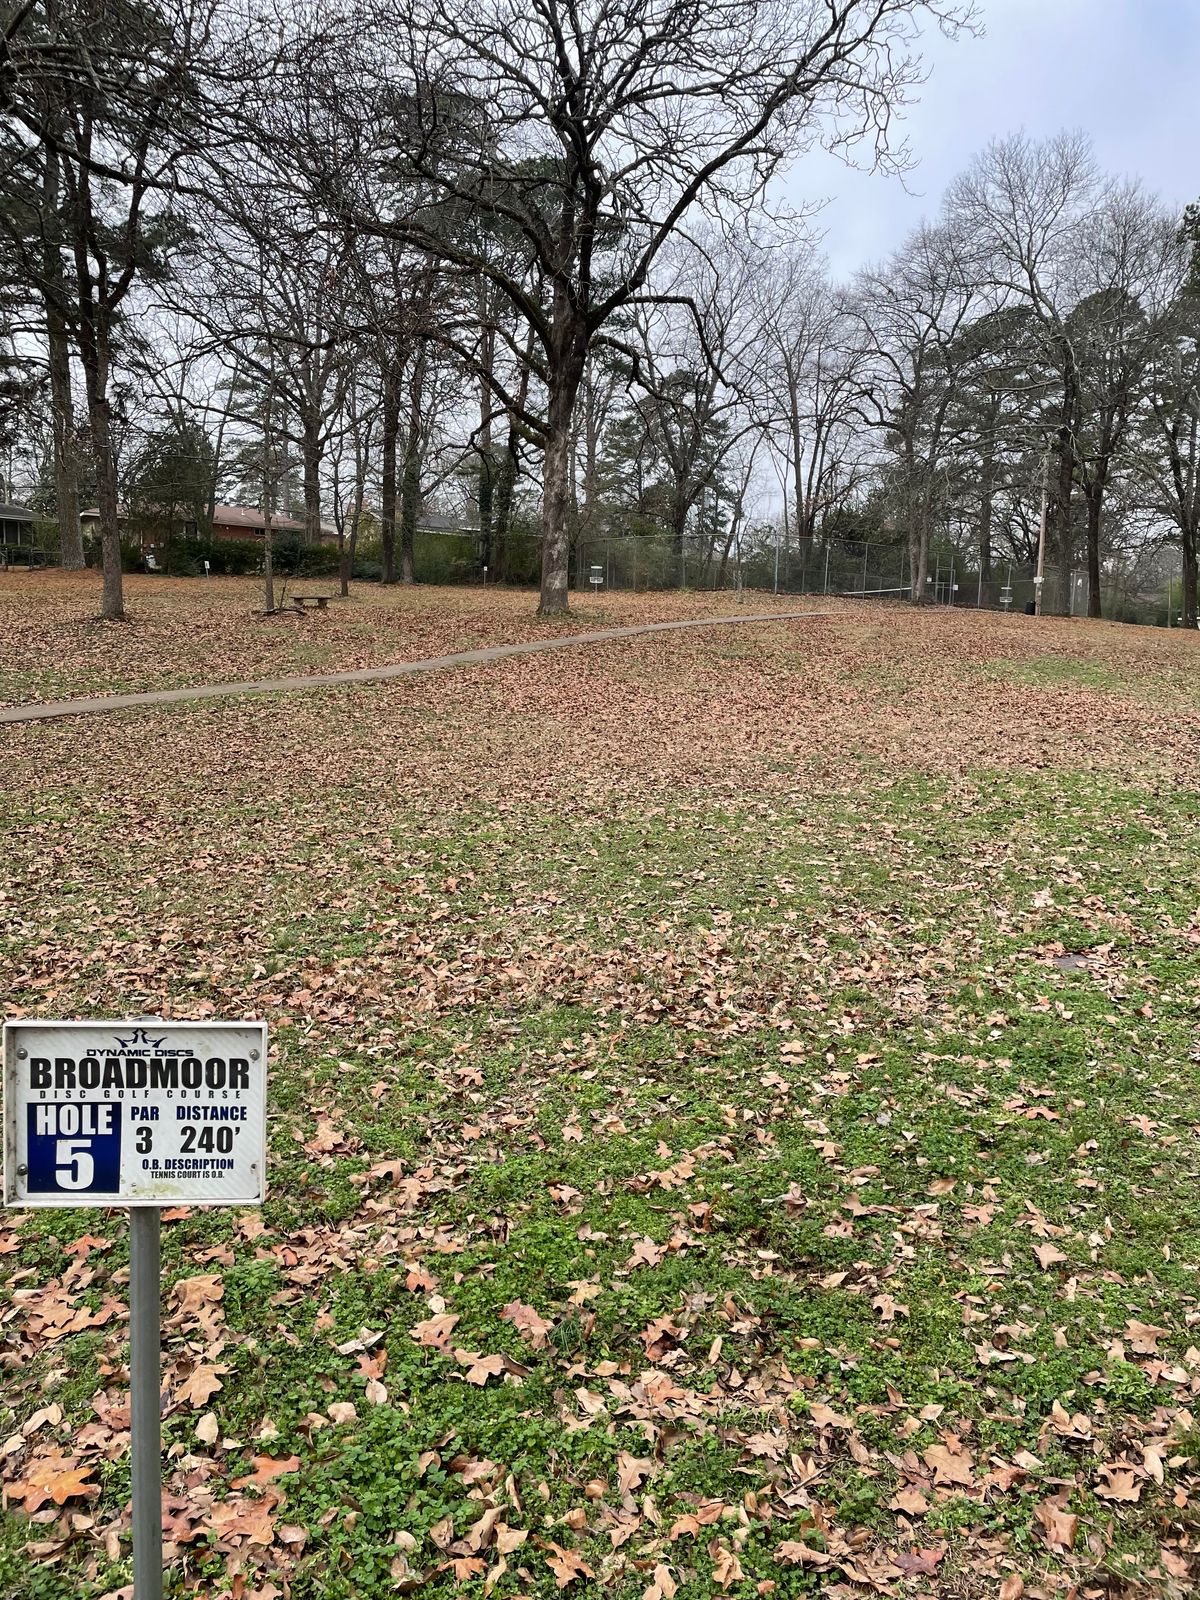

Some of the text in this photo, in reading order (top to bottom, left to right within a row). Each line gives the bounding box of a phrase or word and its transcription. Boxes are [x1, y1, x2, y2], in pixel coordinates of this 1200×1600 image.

[30, 1058, 249, 1089] BROADMOOR
[40, 1090, 240, 1099] DISC GOLF COURSE
[36, 1104, 113, 1136] HOLE
[131, 1106, 159, 1121] PAR
[176, 1106, 247, 1121] DISTANCE
[136, 1126, 152, 1154] 3
[180, 1126, 240, 1154] 240'
[55, 1139, 94, 1190] 5
[142, 1159, 234, 1170] O.B. DESCRIPTION
[151, 1171, 224, 1179] TENNIS COURT IS O.B.
